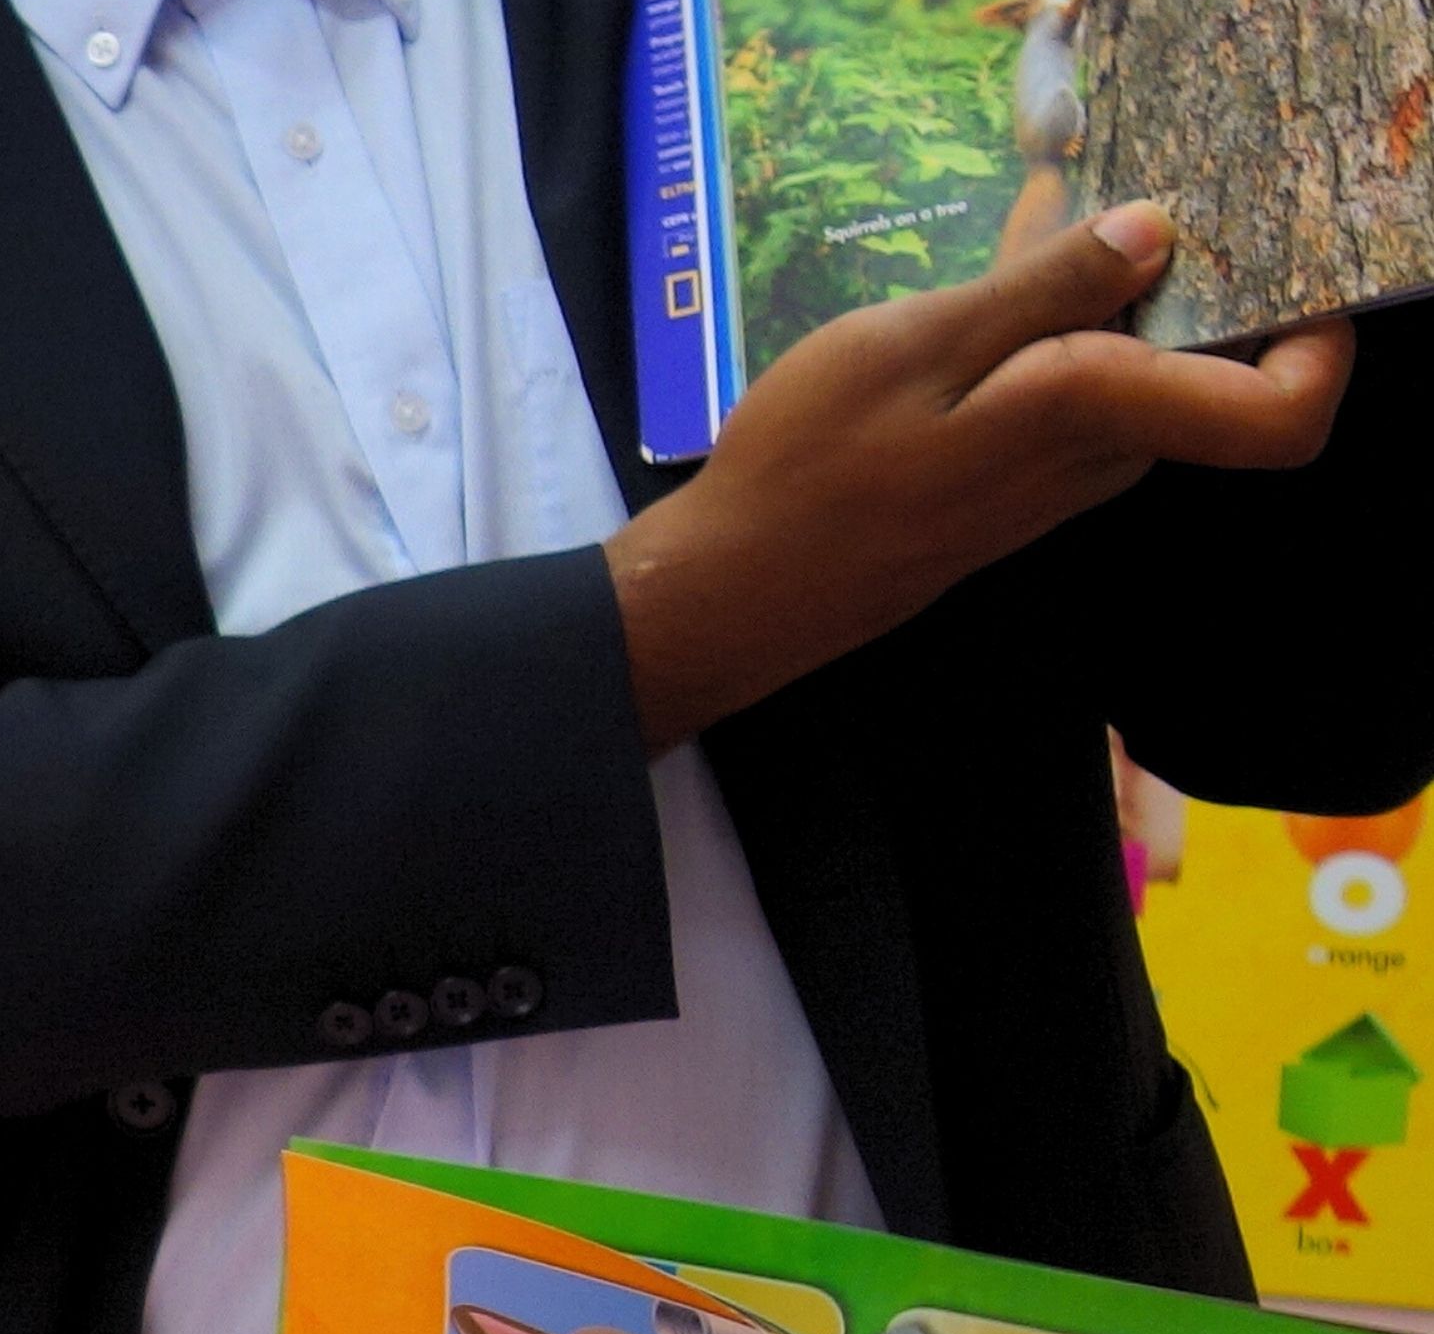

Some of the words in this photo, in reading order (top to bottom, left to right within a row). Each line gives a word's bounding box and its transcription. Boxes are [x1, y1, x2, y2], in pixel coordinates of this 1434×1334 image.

[824, 213, 892, 245] Squirrels
[894, 212, 917, 228] on
[918, 208, 933, 221] a
[934, 200, 968, 218] tree
[1305, 945, 1406, 975] orange
[1284, 1143, 1372, 1226] X
[1298, 1226, 1350, 1255] box
